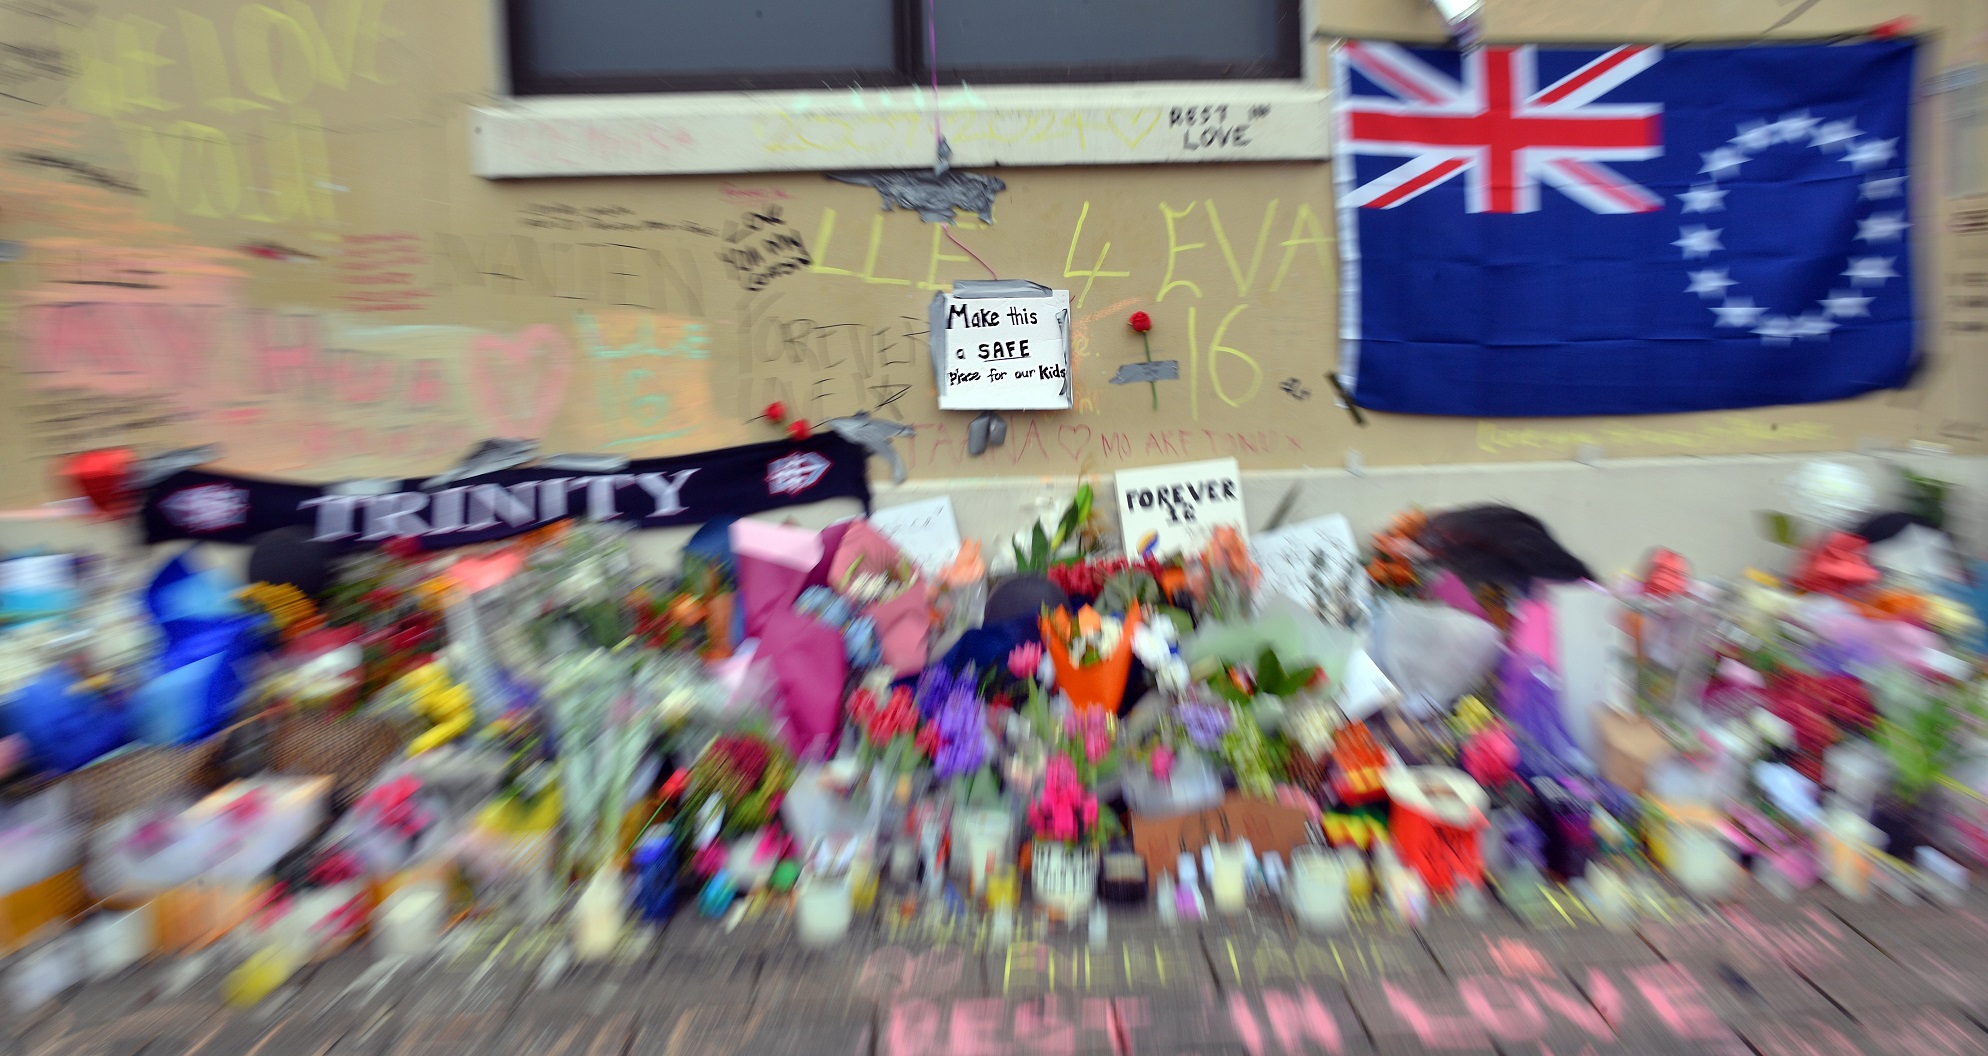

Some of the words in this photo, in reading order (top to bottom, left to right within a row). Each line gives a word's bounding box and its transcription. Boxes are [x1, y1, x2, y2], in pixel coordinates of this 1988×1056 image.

[1183, 126, 1252, 151] LOVE
[1063, 201, 1131, 309] 4
[1155, 197, 1341, 303] EVA
[945, 303, 1000, 330] Make
[1006, 306, 1038, 326] this
[956, 348, 966, 360] a
[978, 339, 1030, 361] SAFE
[1188, 303, 1264, 422] 16
[987, 367, 1008, 383] for
[1014, 368, 1036, 379] our
[1038, 363, 1066, 380] Kids
[297, 468, 701, 542] TRINITY
[1125, 477, 1238, 513] FOREVER
